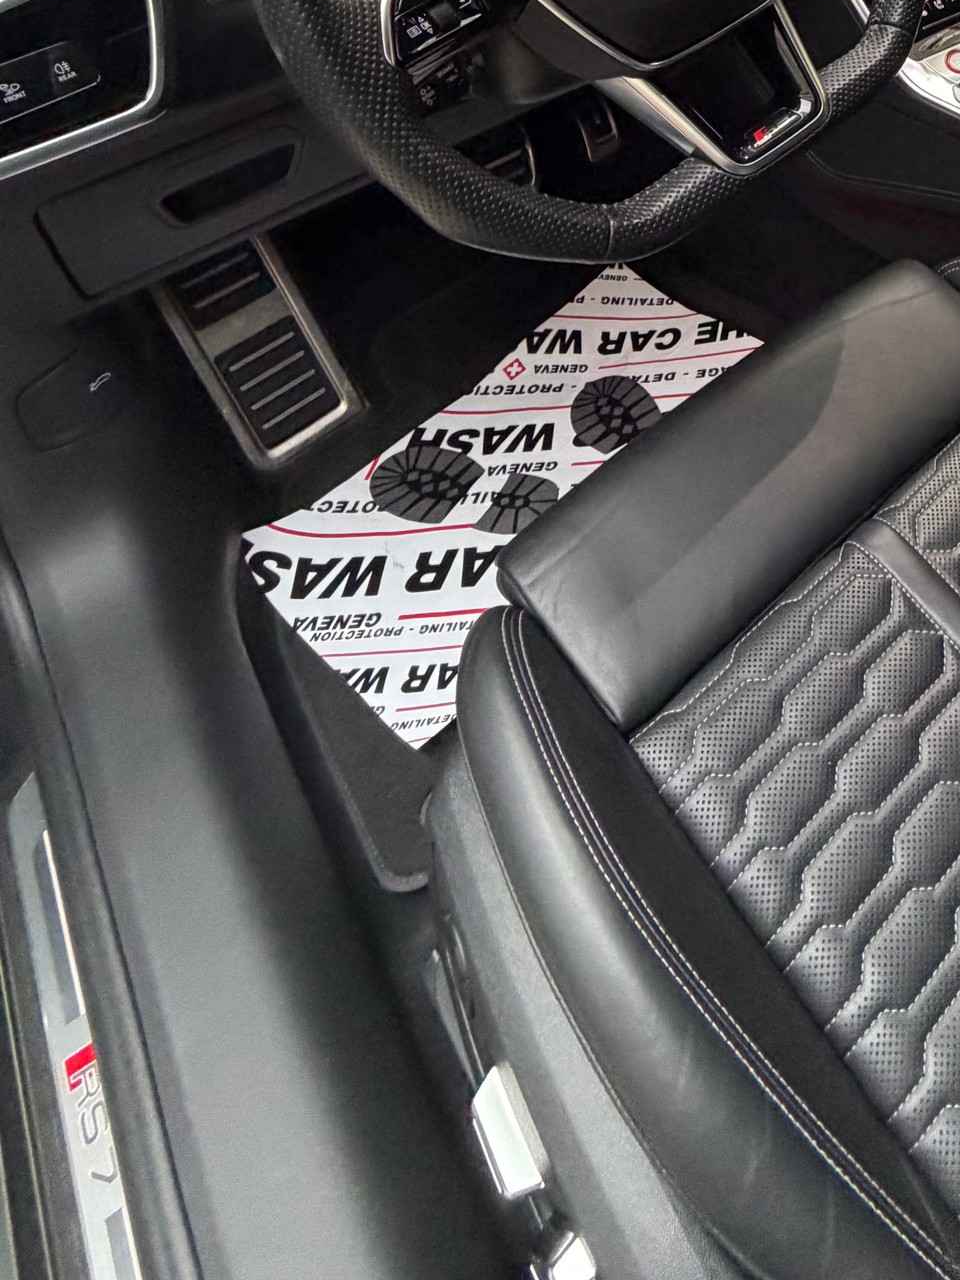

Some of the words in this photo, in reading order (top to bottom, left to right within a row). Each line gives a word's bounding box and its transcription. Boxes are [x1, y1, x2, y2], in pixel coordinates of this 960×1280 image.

[57, 71, 78, 82] REAR
[3, 90, 27, 104] FRONT
[597, 327, 682, 356] CAR
[534, 363, 589, 375] GENEVA
[486, 460, 559, 478] GENEVA
[293, 612, 382, 634] GENEVA
[310, 626, 402, 642] PROTECTION
